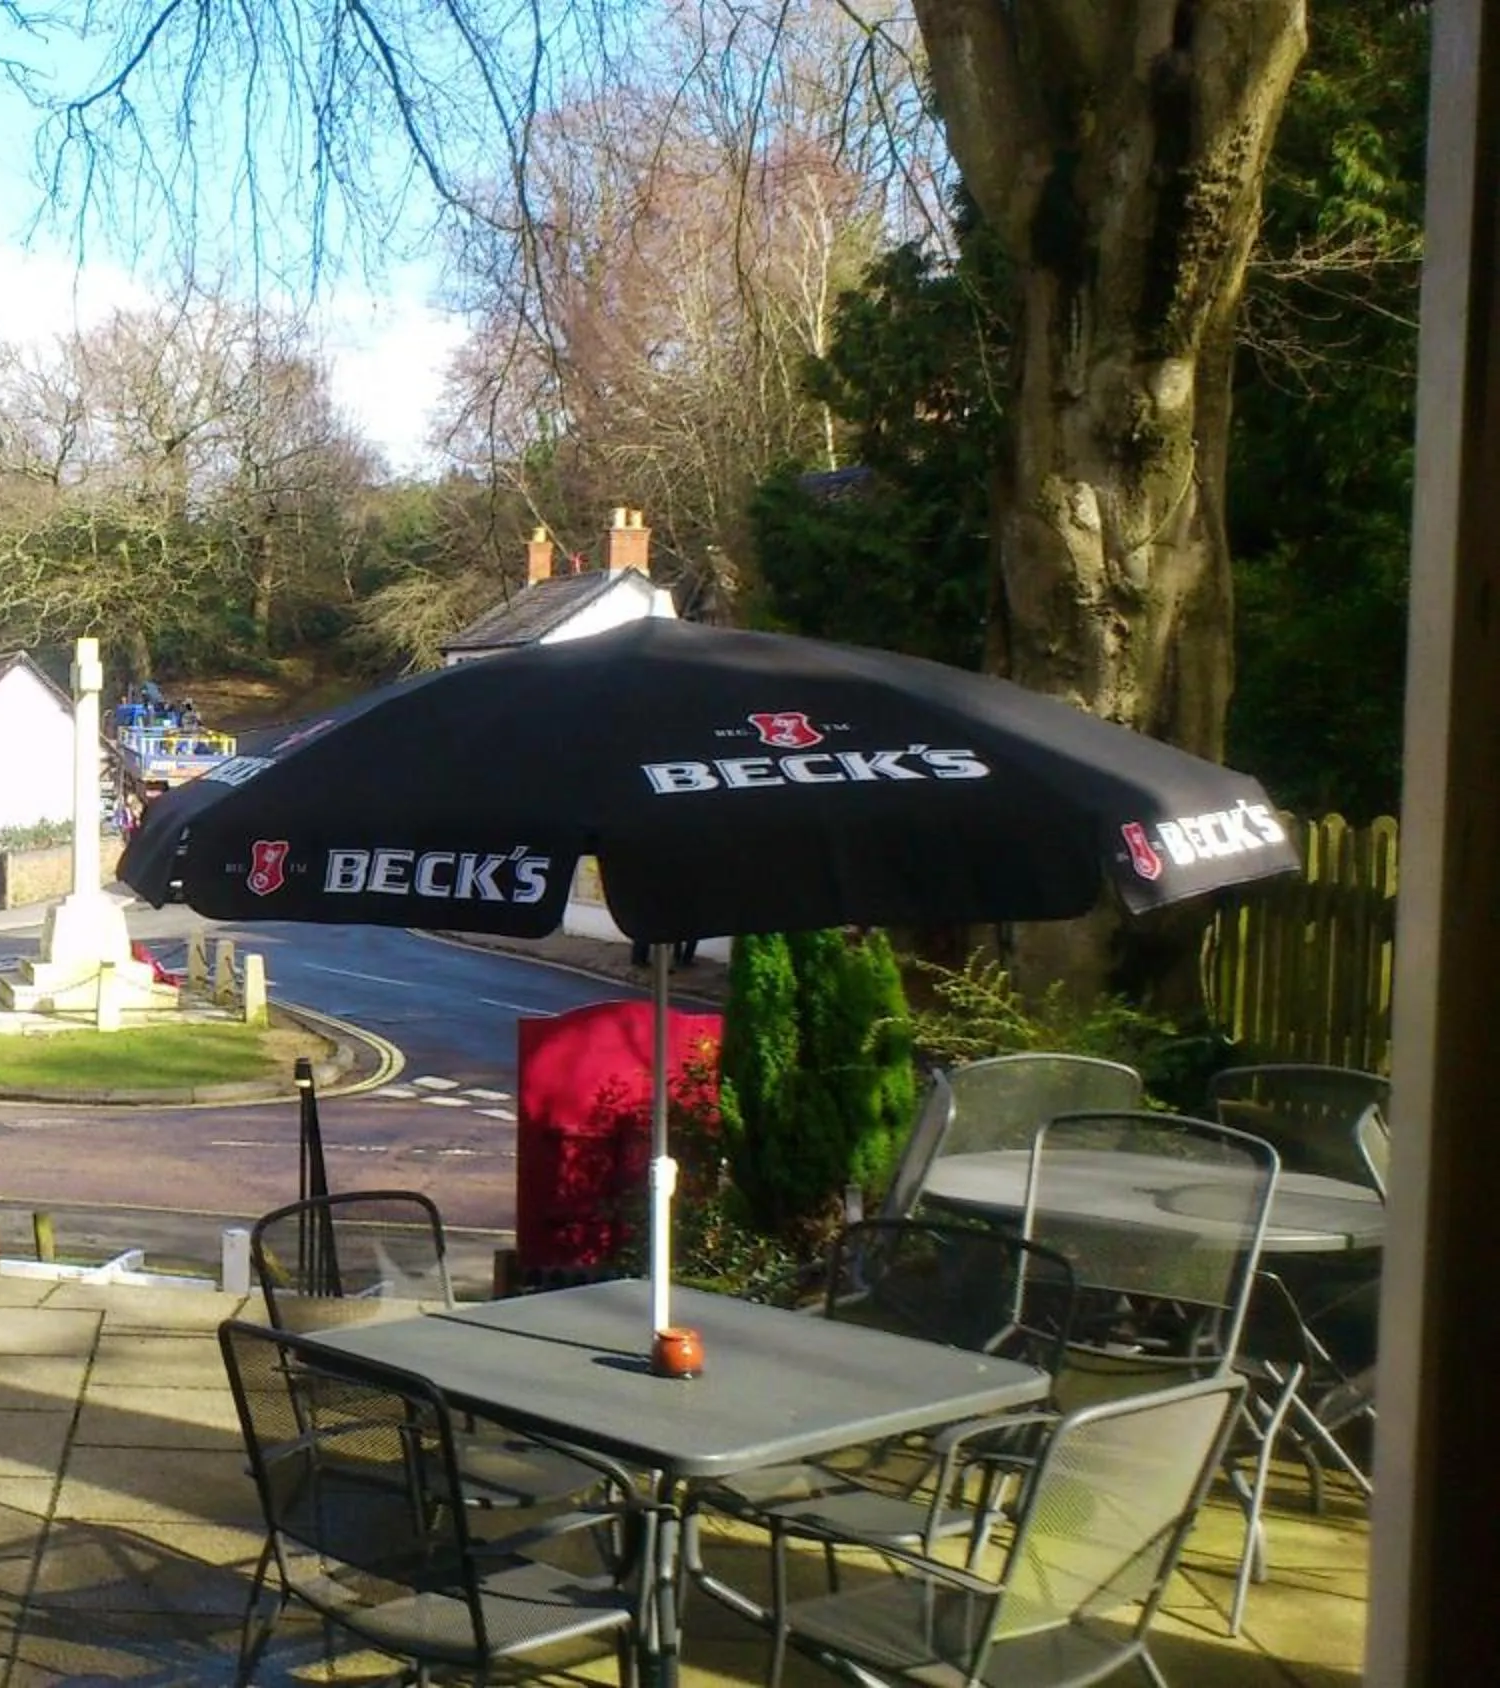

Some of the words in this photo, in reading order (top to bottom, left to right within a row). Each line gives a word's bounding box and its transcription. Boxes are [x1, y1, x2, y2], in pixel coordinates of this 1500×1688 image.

[640, 743, 991, 795] BECK'S
[1156, 799, 1286, 866] BECK'S
[323, 845, 550, 904] BECK'S
